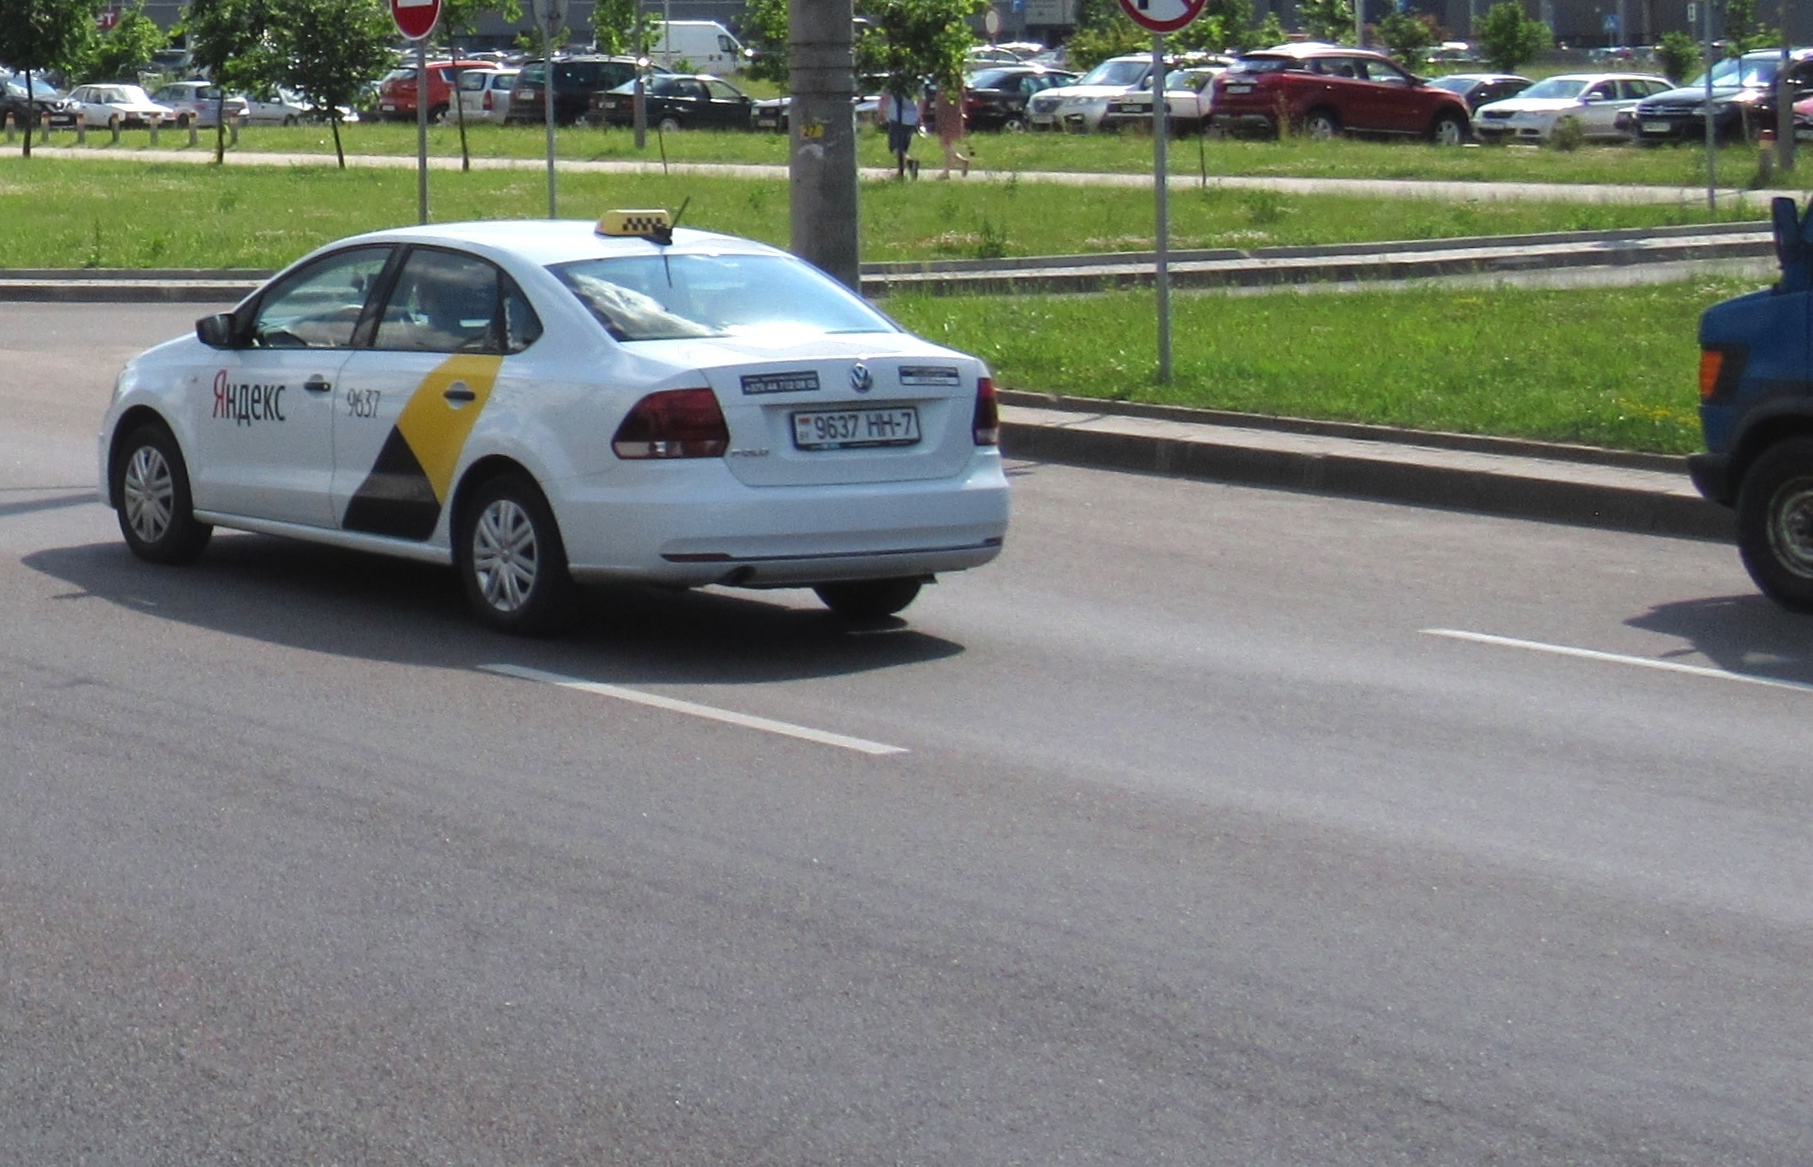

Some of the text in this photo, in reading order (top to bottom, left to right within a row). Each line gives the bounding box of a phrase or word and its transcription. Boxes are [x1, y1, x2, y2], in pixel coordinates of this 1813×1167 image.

[213, 369, 286, 427] Яндекс
[346, 388, 381, 418] 9637
[814, 414, 859, 439] 9637
